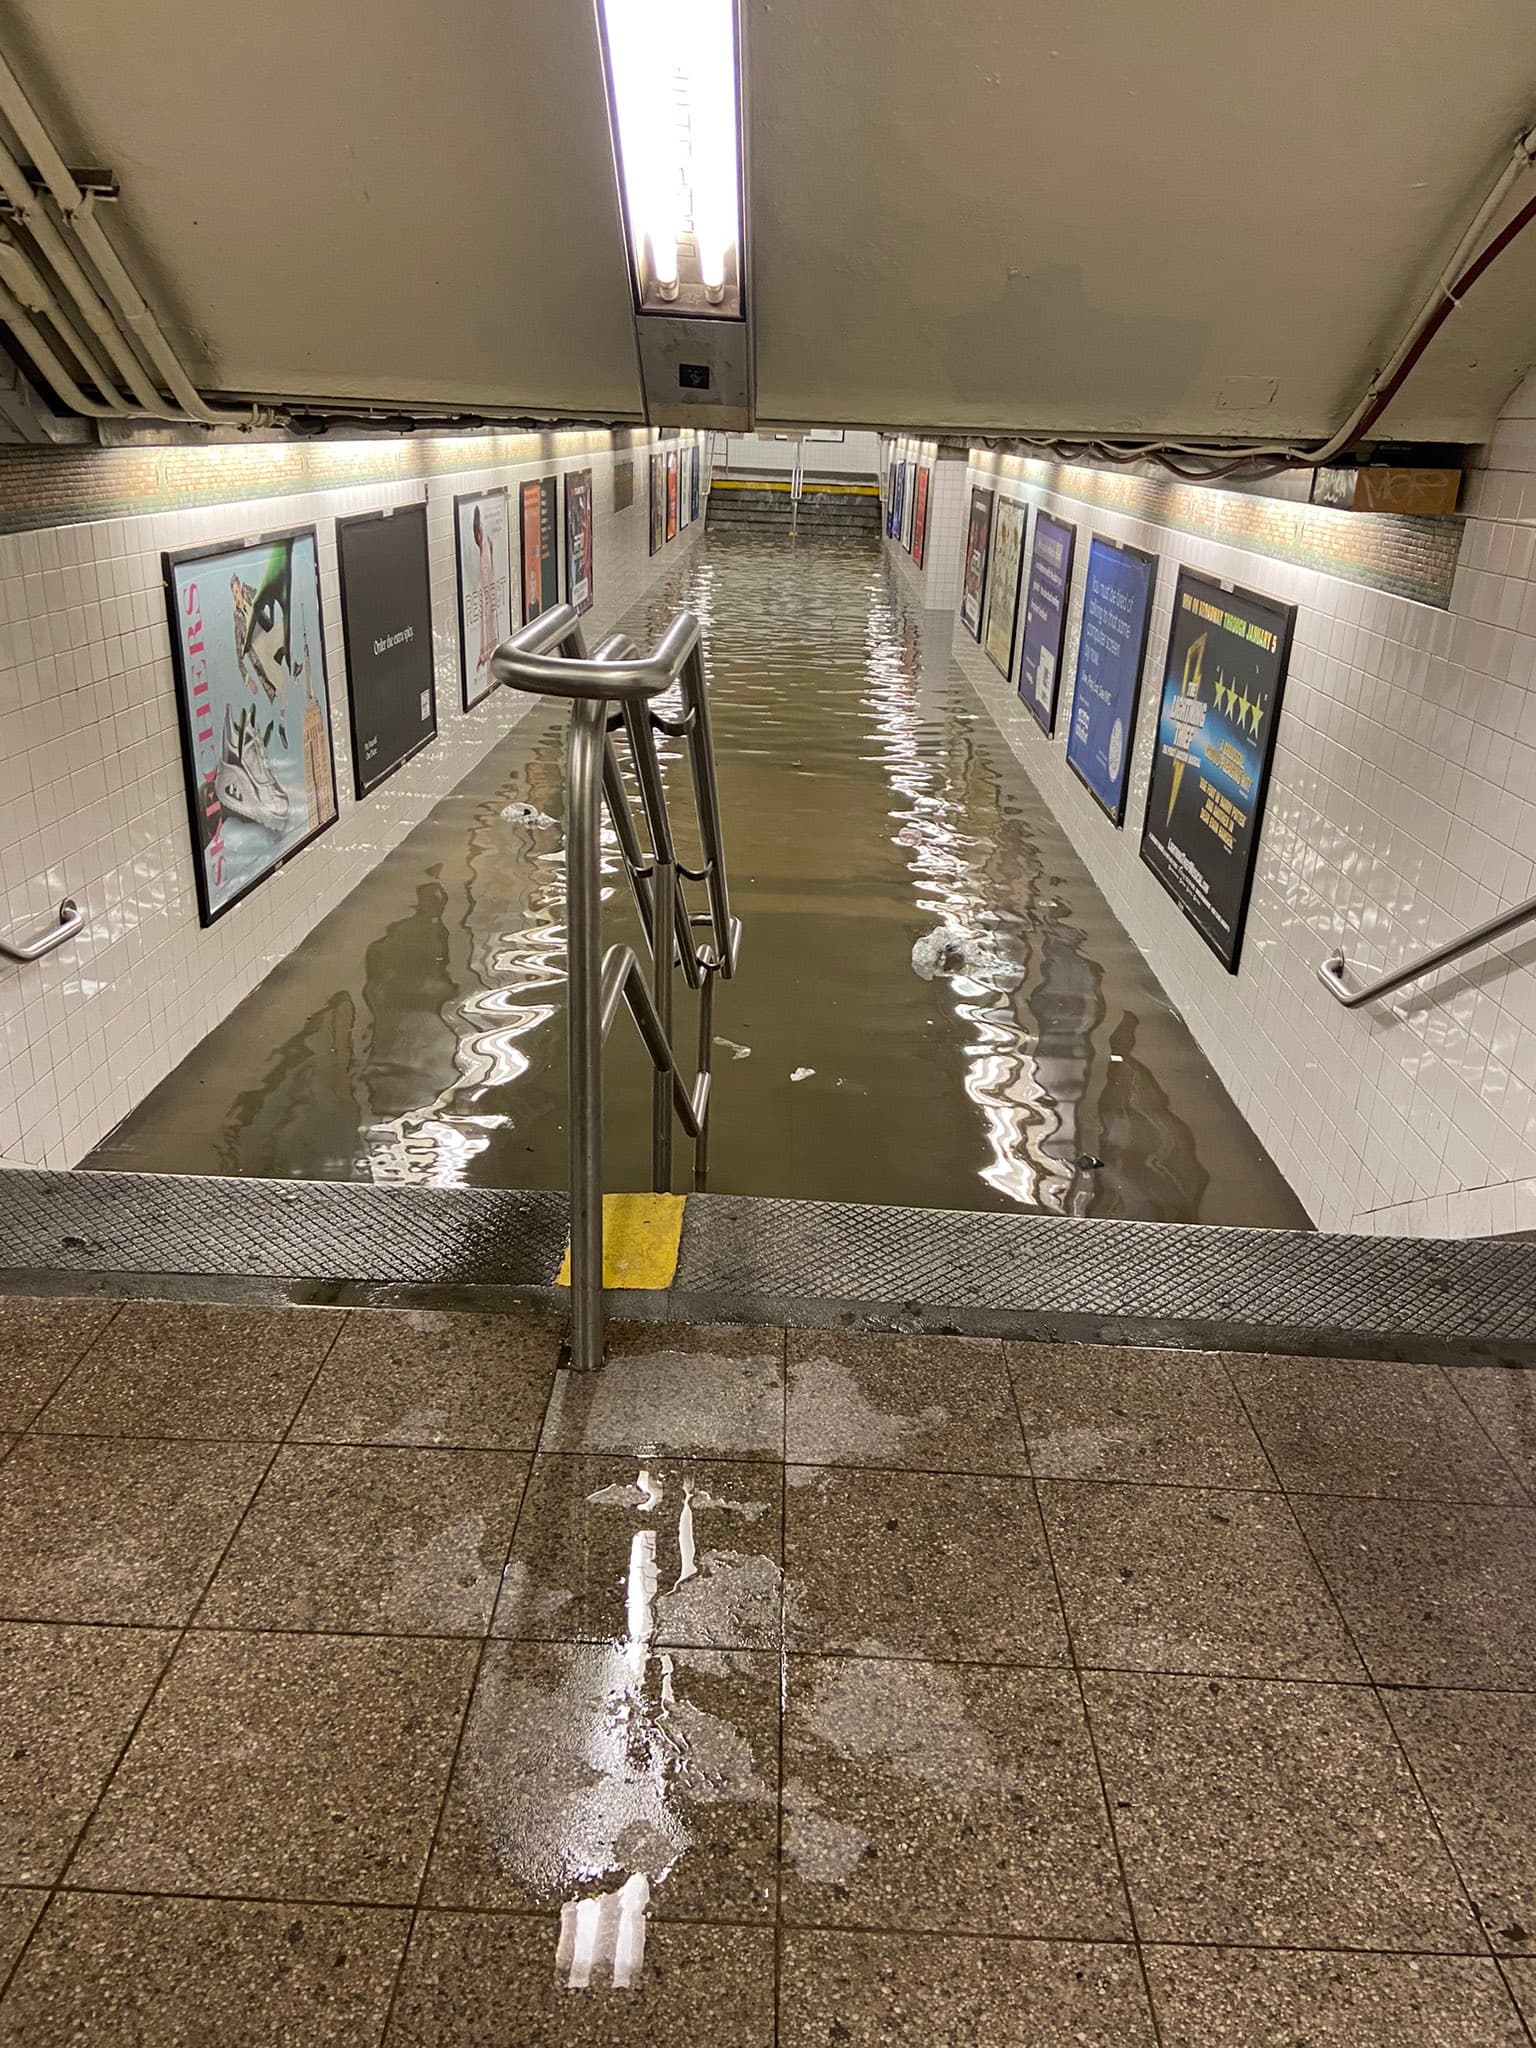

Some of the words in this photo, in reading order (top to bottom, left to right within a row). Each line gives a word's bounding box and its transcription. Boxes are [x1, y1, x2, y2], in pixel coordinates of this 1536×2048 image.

[1198, 600, 1225, 627] BROADWAY
[1222, 611, 1248, 638] THROUGH
[1245, 623, 1273, 652] JANUARY
[1271, 634, 1278, 655] 5
[183, 581, 228, 888] SKECHERS
[1168, 694, 1208, 728] LIGHTNING
